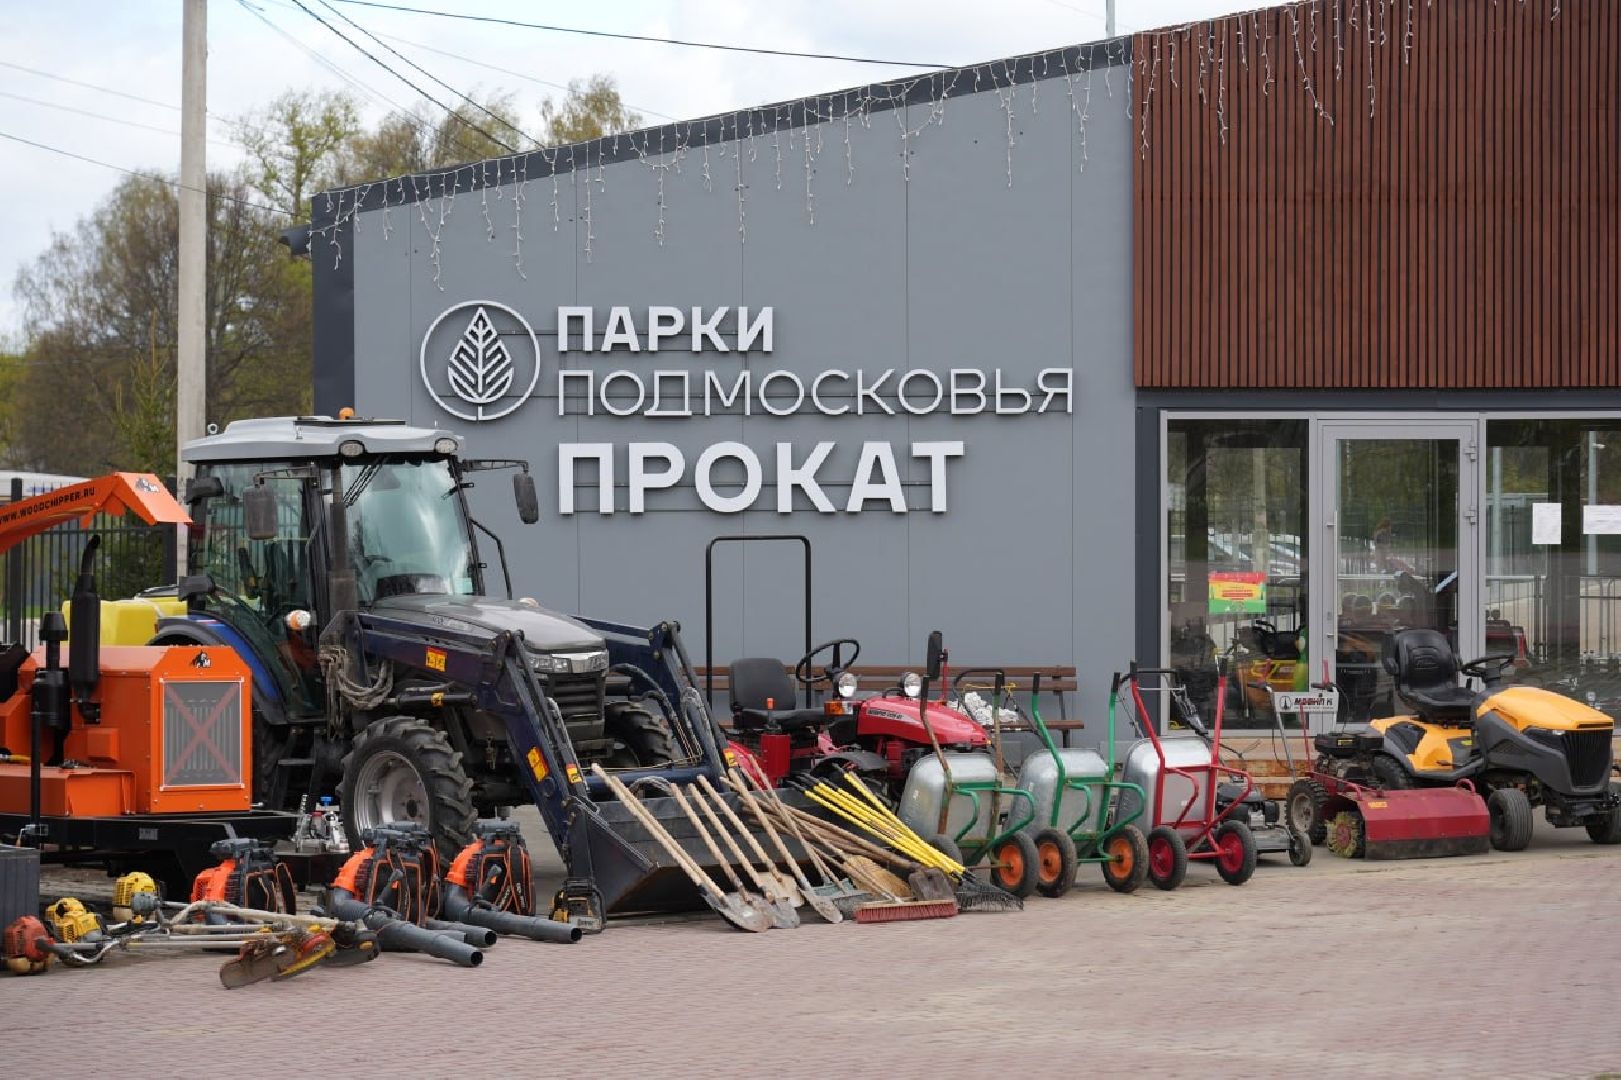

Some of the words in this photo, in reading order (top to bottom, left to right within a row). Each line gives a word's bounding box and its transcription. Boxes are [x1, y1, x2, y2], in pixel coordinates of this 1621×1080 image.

[558, 306, 773, 351] ПАРКИ
[558, 368, 1074, 418] ПОДМОСКОВЬЯ
[558, 441, 964, 513] ПРОКАТ
[0, 487, 95, 524] WW.WOODCHIPPER.RU
